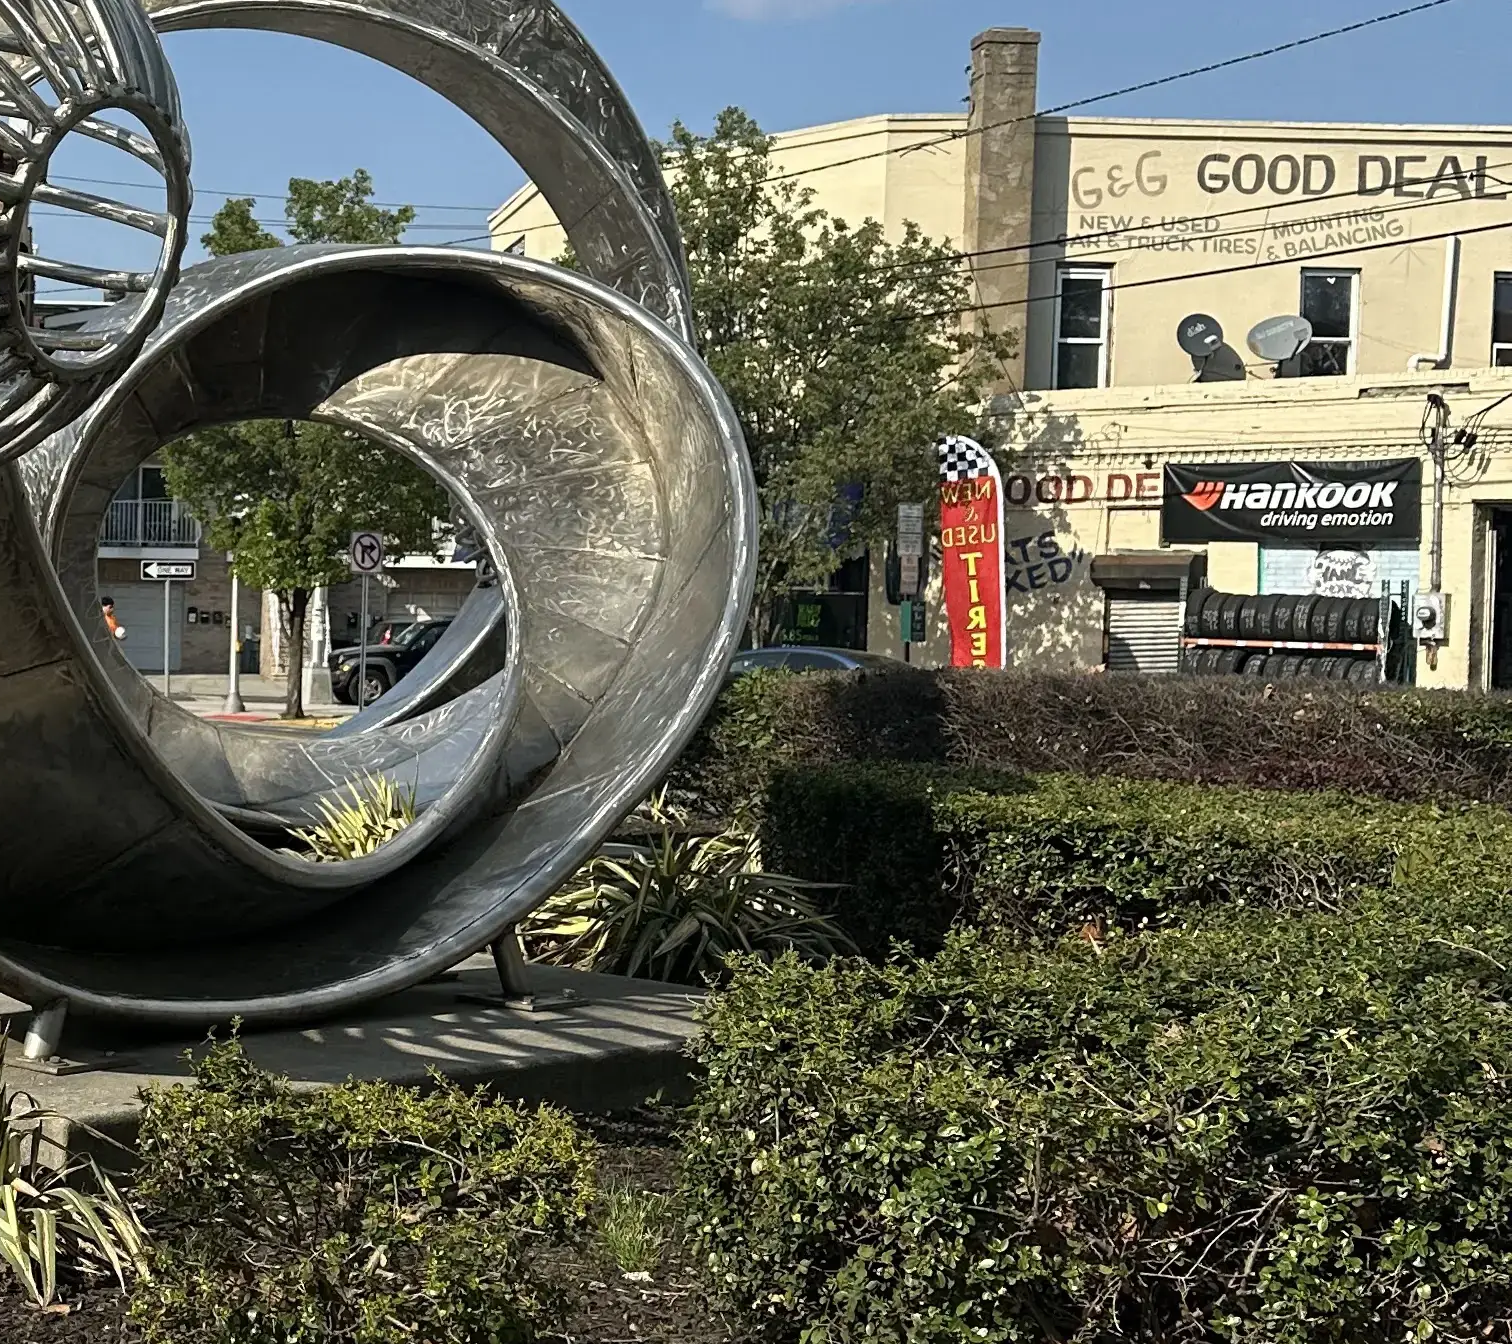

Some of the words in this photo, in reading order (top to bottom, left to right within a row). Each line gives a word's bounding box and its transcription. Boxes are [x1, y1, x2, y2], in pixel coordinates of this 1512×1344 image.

[1072, 150, 1168, 210] G&G
[1196, 153, 1336, 195] GOOD
[1357, 155, 1507, 201] DEAL
[1079, 214, 1134, 230] NEW
[1160, 216, 1221, 233] USED
[1272, 205, 1385, 240] MOUNTING
[1124, 234, 1194, 253] TRUCK
[1200, 237, 1257, 255] TIRES
[1266, 245, 1281, 261] &
[1284, 218, 1404, 258] BALANCING
[1004, 474, 1094, 505] OOD
[1107, 472, 1161, 502] DE
[1260, 510, 1318, 530] driving
[1321, 510, 1394, 526] emotion
